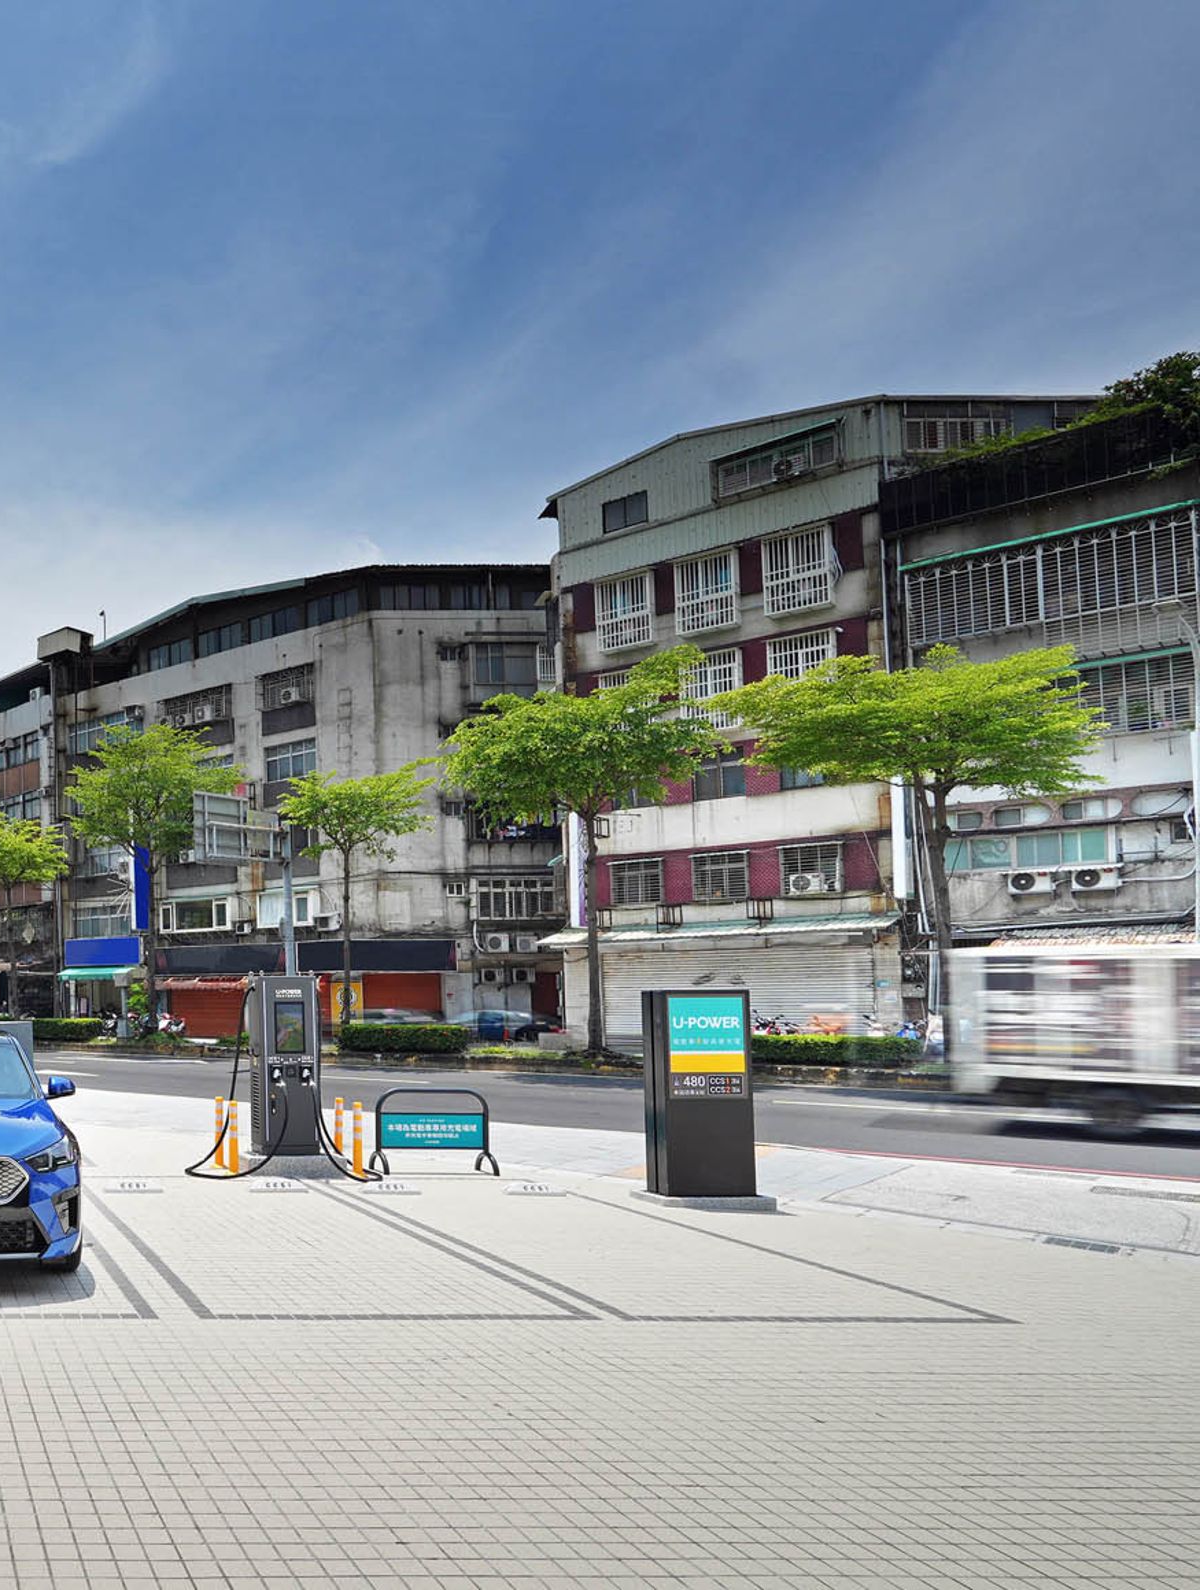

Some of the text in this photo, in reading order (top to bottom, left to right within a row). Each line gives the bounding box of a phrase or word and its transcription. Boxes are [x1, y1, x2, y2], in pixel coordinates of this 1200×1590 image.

[672, 1016, 740, 1029] U-POWER
[683, 1075, 706, 1087] 480
[709, 1077, 730, 1085] CCS1
[709, 1086, 731, 1094] CCS2
